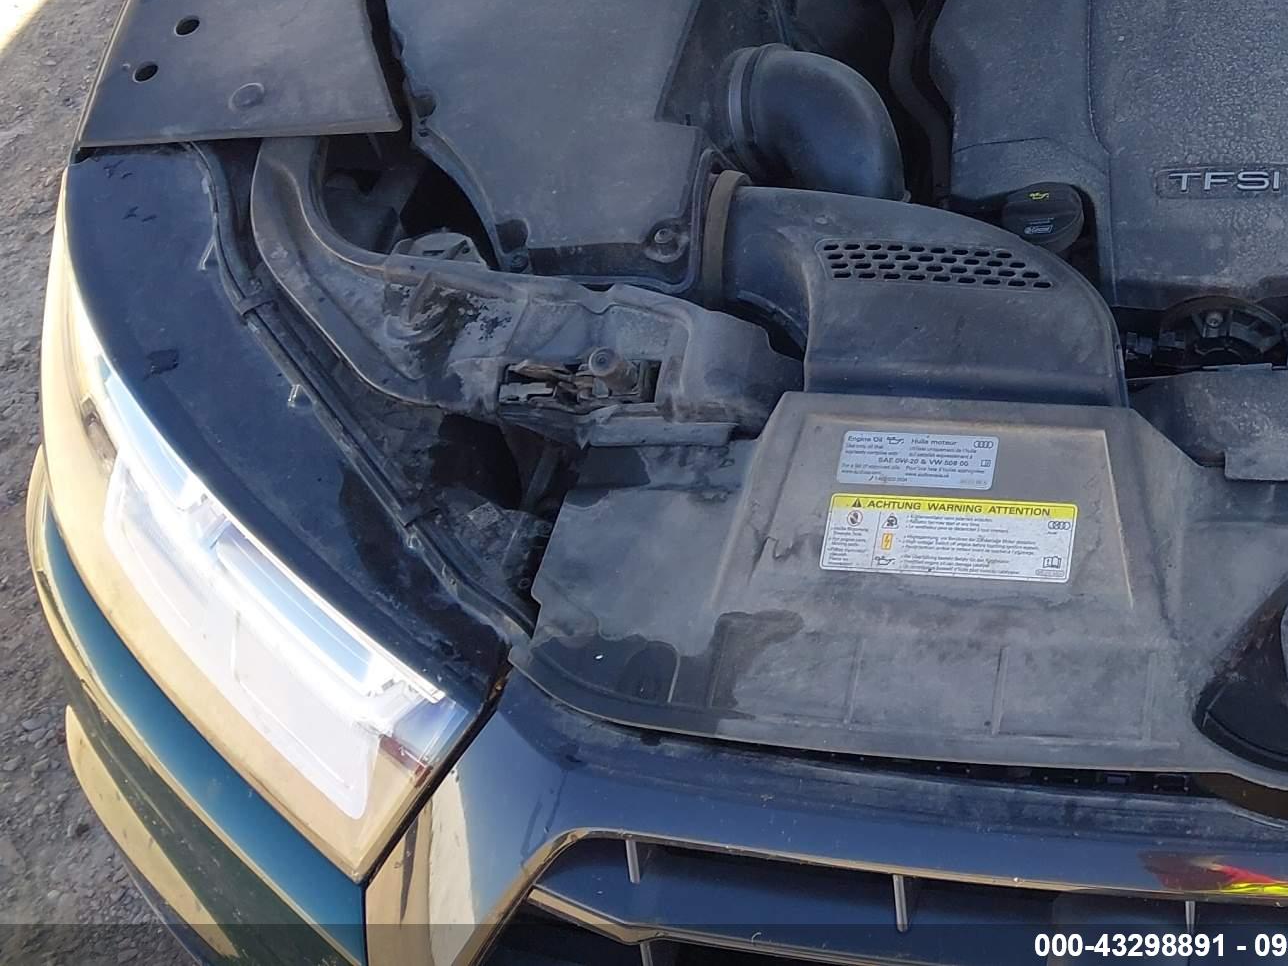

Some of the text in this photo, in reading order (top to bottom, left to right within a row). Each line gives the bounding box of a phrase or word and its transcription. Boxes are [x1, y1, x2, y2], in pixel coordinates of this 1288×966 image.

[1168, 171, 1280, 192] TFSI
[848, 435, 871, 443] Engine
[867, 500, 1050, 516] ACHTUNG WARNING ATTENTION
